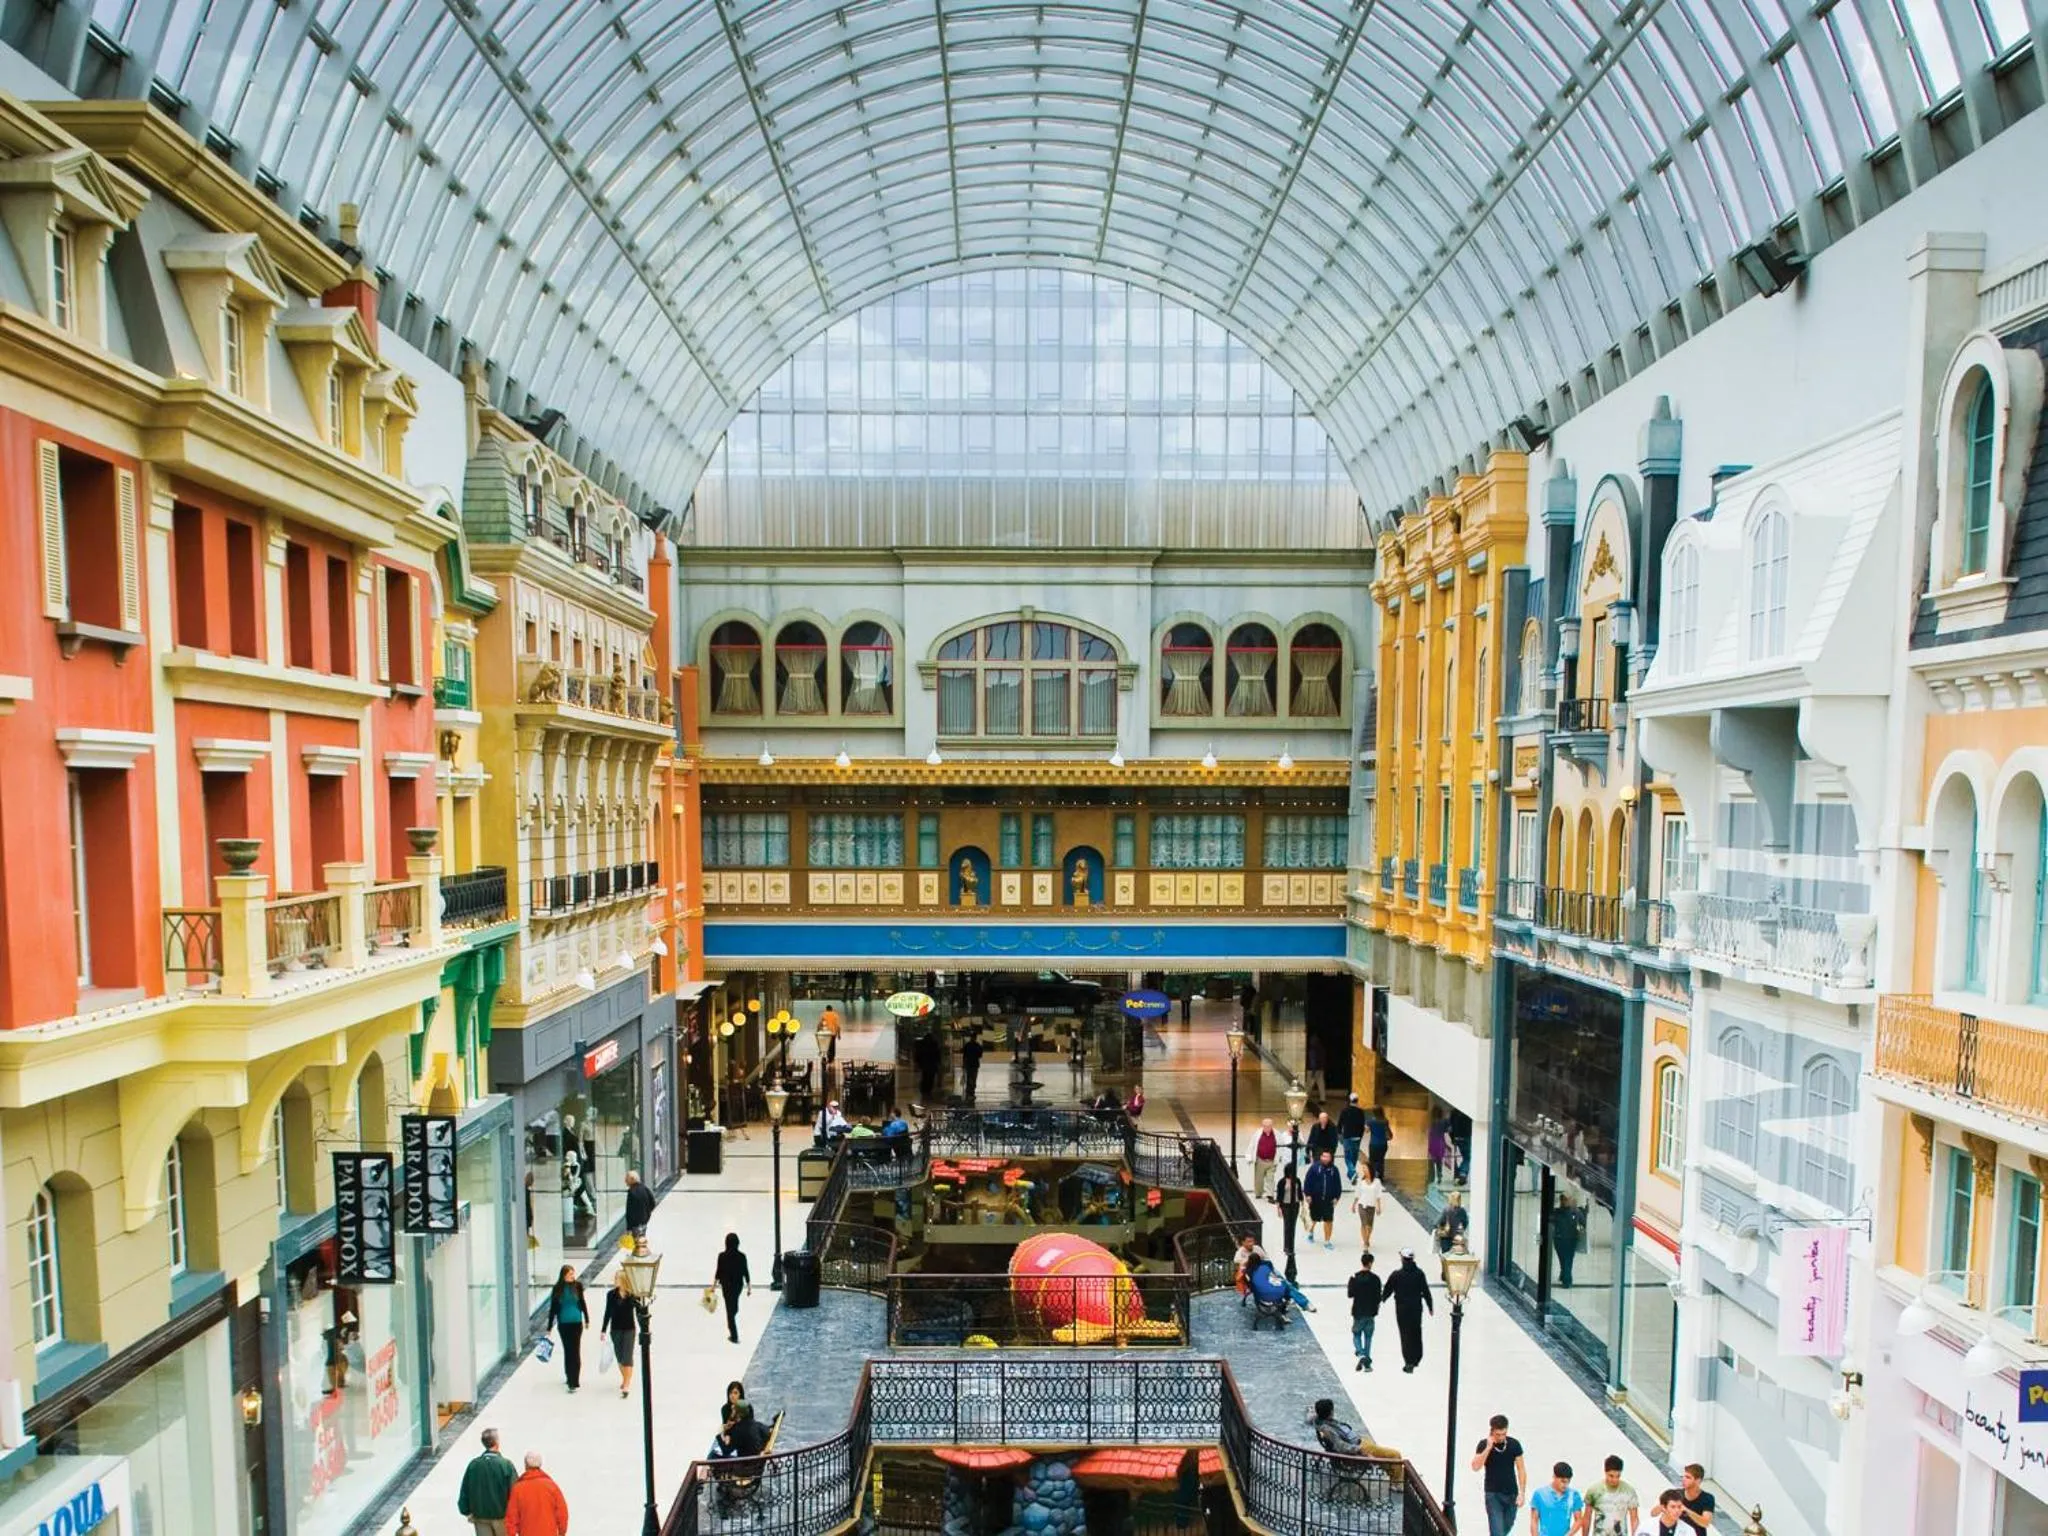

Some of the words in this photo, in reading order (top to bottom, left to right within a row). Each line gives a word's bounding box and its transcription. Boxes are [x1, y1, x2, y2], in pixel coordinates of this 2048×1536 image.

[337, 1159, 359, 1276] PARADOX
[406, 1122, 424, 1228] PARADOX
[1802, 1296, 1822, 1342] beauty
[1965, 1390, 2010, 1461] beauty
[2020, 1436, 2048, 1470] jun
